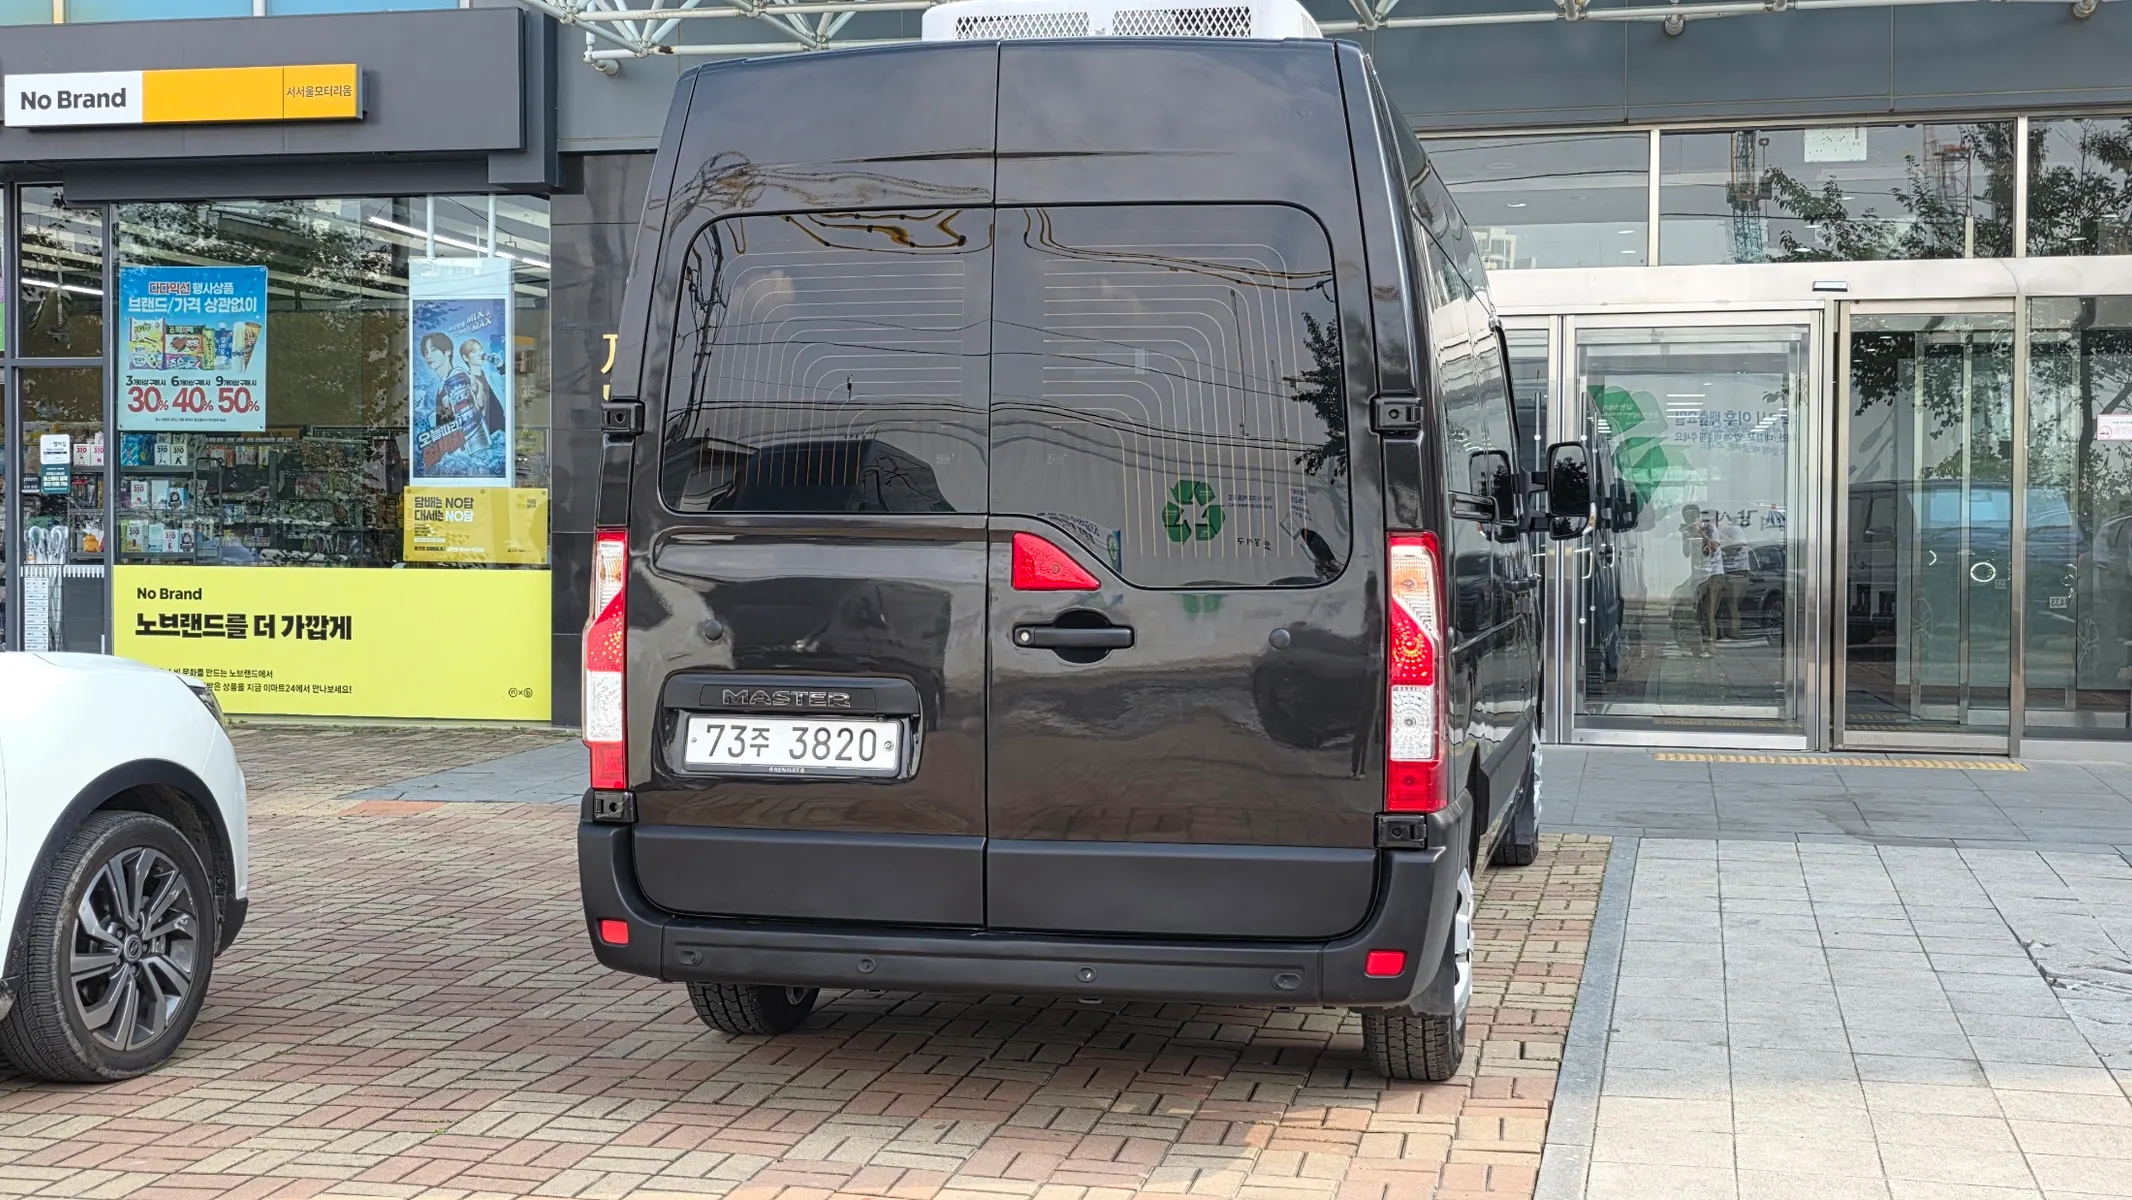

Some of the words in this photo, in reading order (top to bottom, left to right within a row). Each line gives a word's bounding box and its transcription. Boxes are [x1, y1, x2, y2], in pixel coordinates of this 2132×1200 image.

[20, 91, 51, 110] No
[57, 87, 127, 109] Brand
[286, 83, 353, 99] 서서울모터리움
[148, 282, 191, 295] 다다익선
[192, 282, 235, 294] 행사상품
[128, 297, 201, 313] 브랜드/가격
[204, 297, 257, 313] 상관없이
[127, 386, 169, 413] 30%
[172, 386, 214, 413] 40%
[218, 386, 260, 413] 50%
[136, 587, 157, 600] No
[159, 587, 203, 600] Brand
[134, 612, 249, 640] 노브랜드를
[253, 614, 276, 639] 더
[281, 614, 353, 641] 가깝게
[205, 668, 228, 678] 만드는
[229, 669, 273, 679] 노브랜드에서
[222, 682, 245, 692] 상품을
[247, 683, 262, 693] 지금
[263, 683, 310, 694] 이마트24에서
[312, 684, 352, 694] 만나보세요!
[722, 689, 850, 708] MASTER
[706, 724, 770, 758] 73주
[788, 726, 877, 762] 3820
